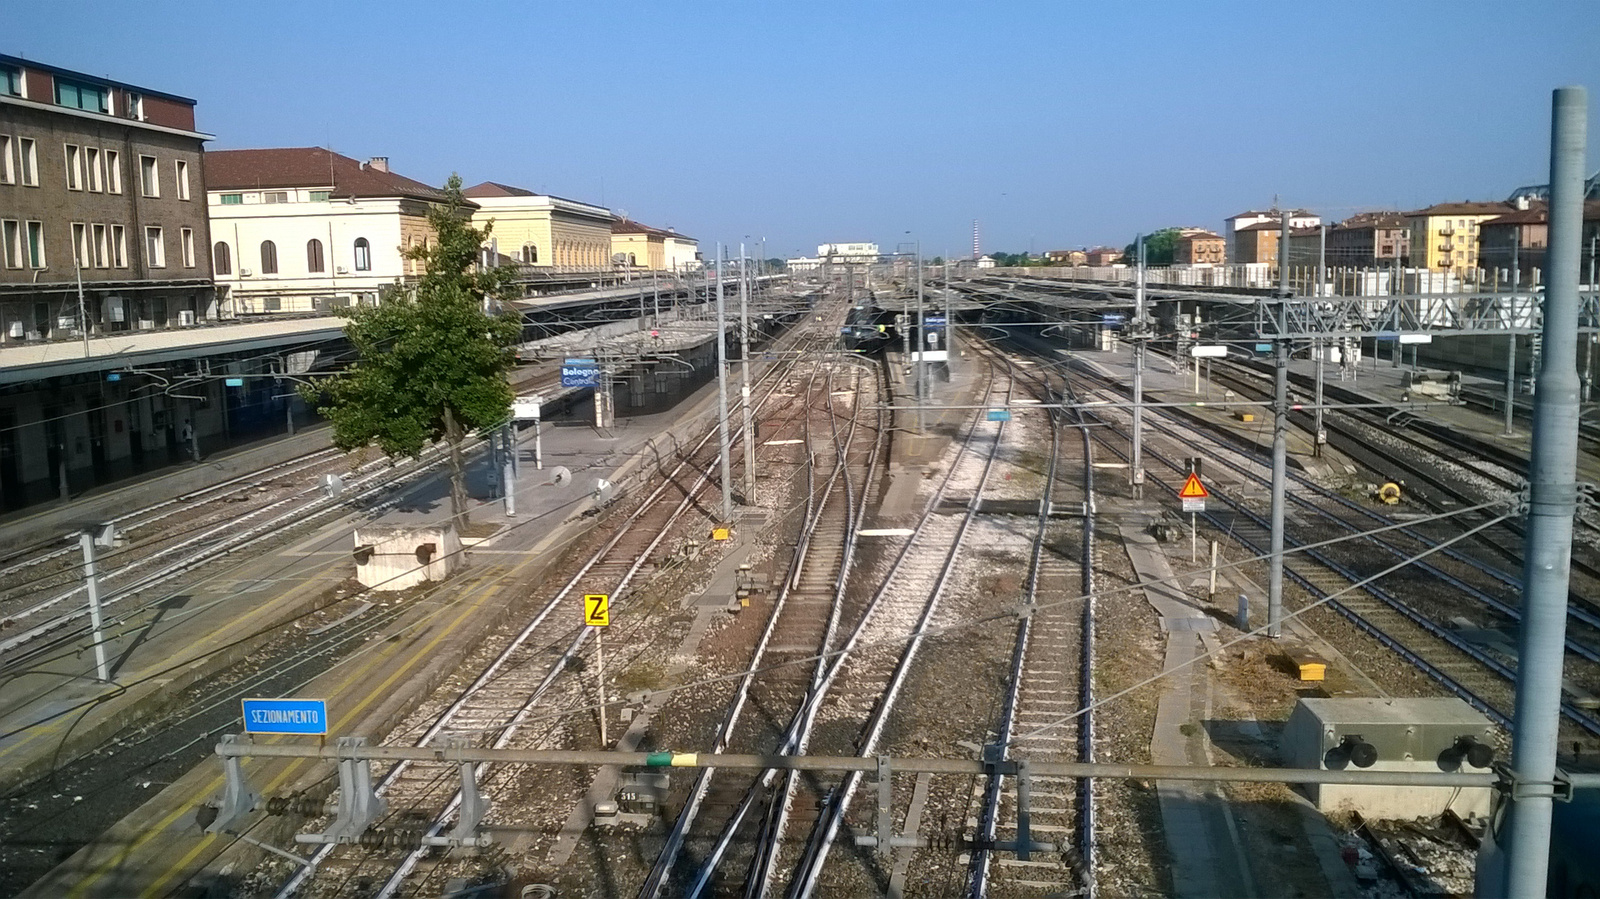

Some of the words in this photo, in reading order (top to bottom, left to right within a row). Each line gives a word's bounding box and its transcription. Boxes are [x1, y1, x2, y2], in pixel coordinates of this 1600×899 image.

[562, 367, 599, 377] Bologna
[589, 597, 604, 620] Z
[251, 709, 319, 724] SEZIONAMENTO
